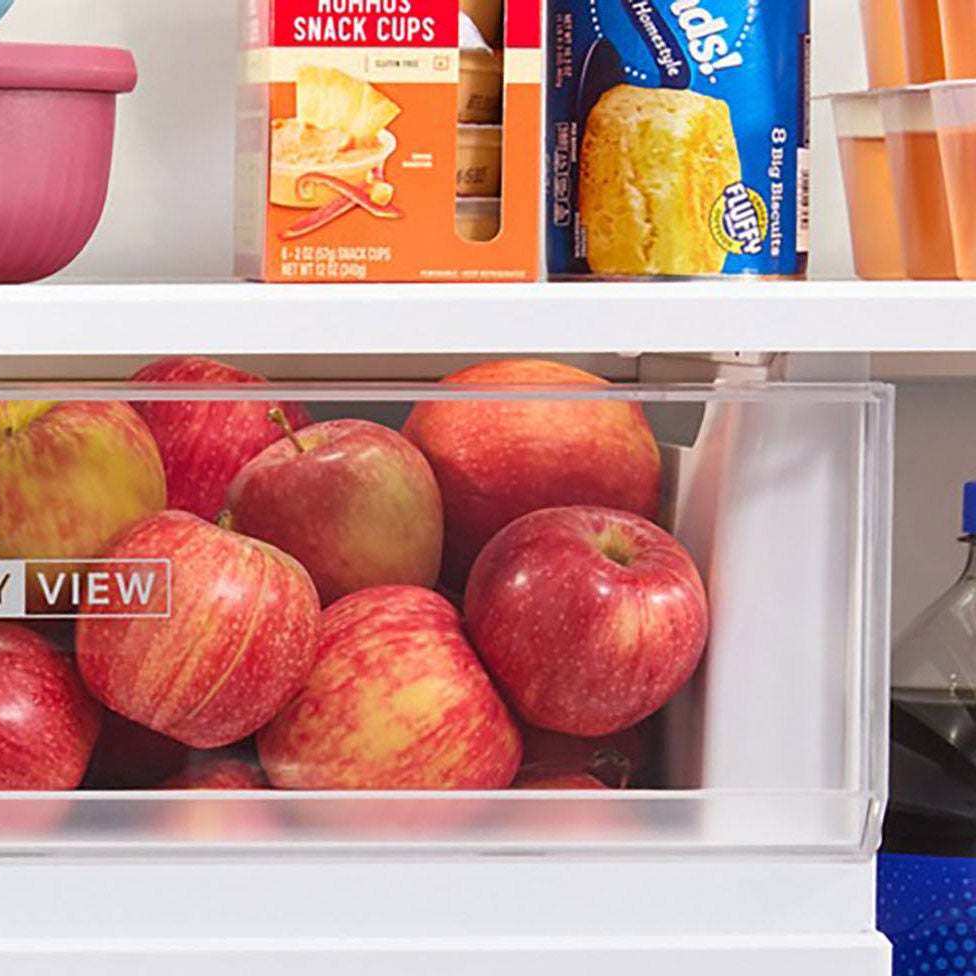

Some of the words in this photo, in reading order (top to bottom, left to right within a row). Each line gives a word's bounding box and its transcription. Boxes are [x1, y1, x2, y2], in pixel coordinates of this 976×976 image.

[294, 16, 367, 41] SNACK
[377, 16, 435, 41] CUPS
[632, 1, 682, 77] Homestyle
[771, 127, 787, 143] 8
[768, 148, 783, 178] Big
[725, 182, 763, 254] FLUFFY
[770, 182, 783, 256] Biscuits
[37, 572, 156, 605] VIEW
